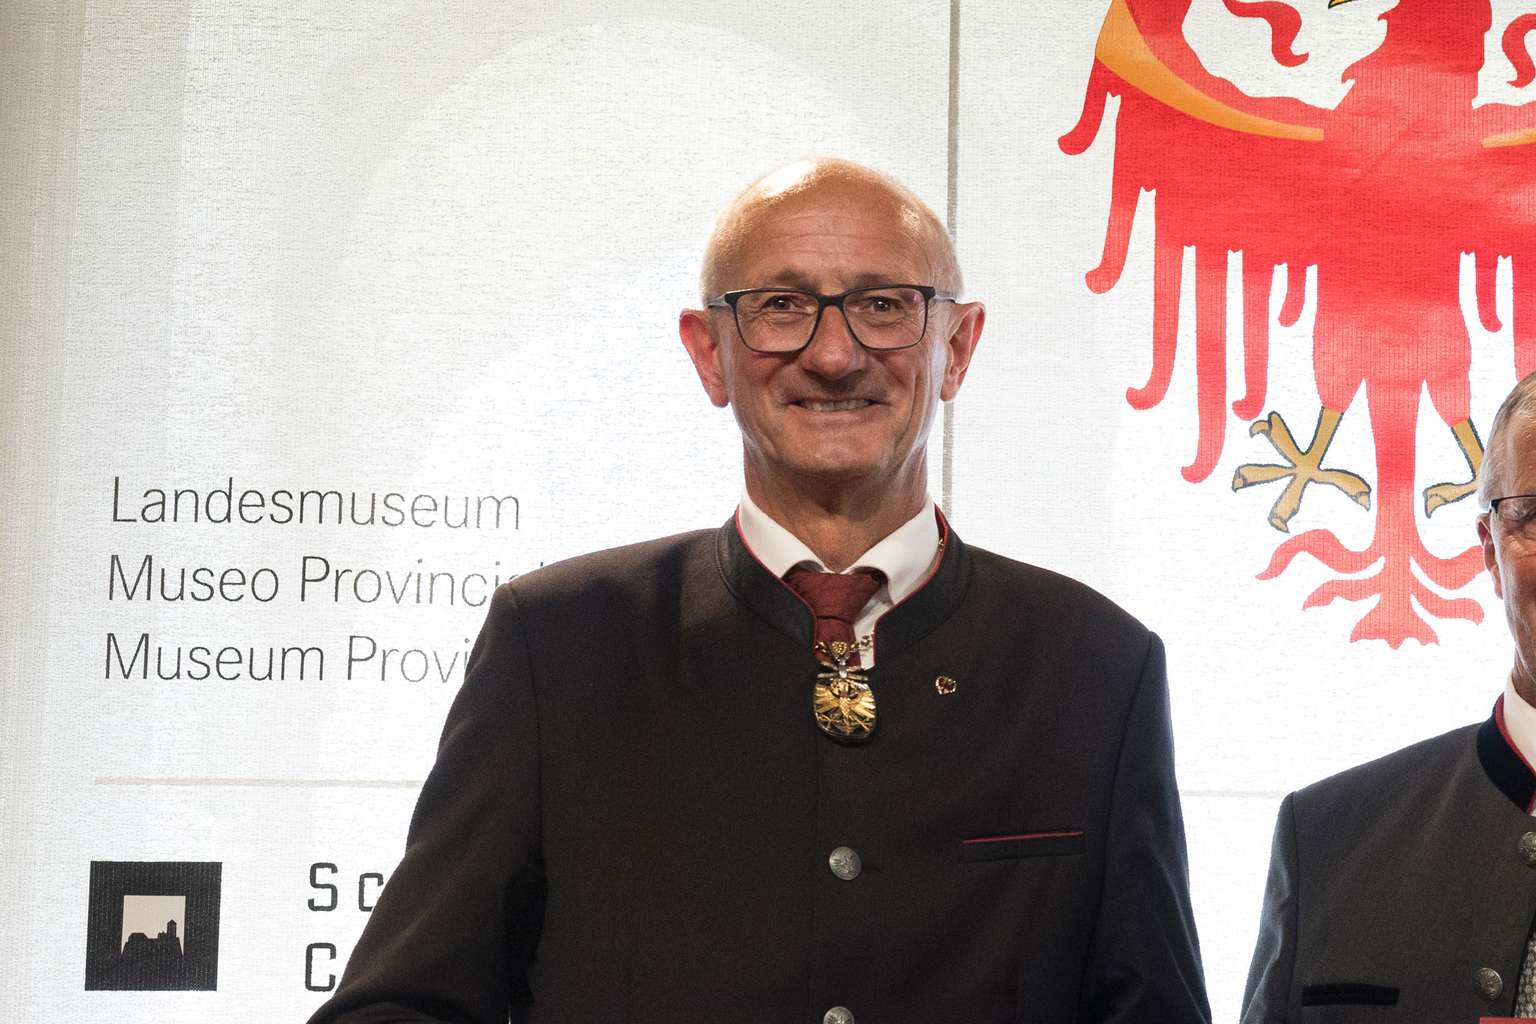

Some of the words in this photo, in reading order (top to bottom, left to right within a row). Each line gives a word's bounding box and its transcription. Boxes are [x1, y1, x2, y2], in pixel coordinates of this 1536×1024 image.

[112, 475, 520, 530] Landesmuseum
[108, 554, 280, 603] Museo
[300, 556, 544, 608] Provinci
[104, 632, 325, 682] Museum
